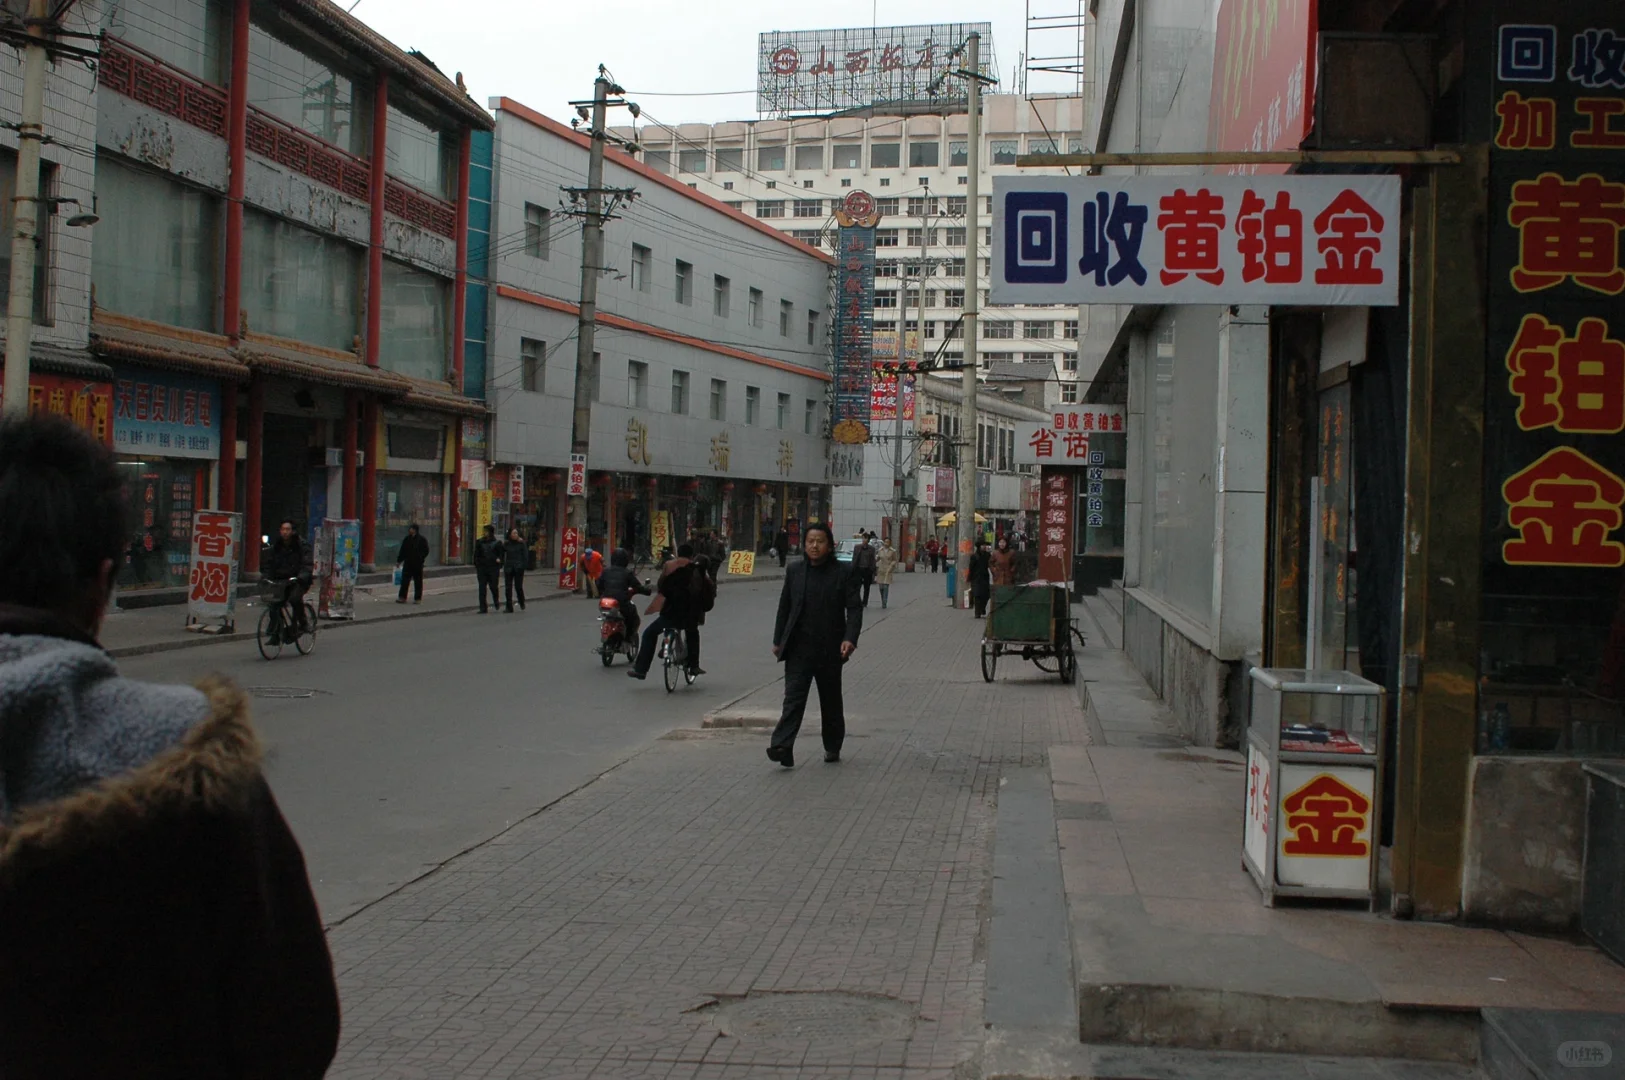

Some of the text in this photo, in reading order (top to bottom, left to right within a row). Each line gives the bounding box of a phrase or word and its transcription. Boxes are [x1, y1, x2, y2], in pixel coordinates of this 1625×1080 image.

[1498, 24, 1625, 90] 回收
[1494, 90, 1625, 151] 加工
[1004, 187, 1385, 288] 回收黄铂金
[1502, 171, 1625, 568] 黄铂金
[624, 415, 794, 477] 凯瑞祥
[1028, 427, 1089, 459] 省话
[1054, 412, 1123, 432] 回收黄铂金
[570, 463, 584, 495] 黄铂金
[1088, 450, 1105, 528] 回收黄铂金
[190, 514, 232, 604] 香烟
[562, 528, 577, 587] 全场2元
[1282, 771, 1372, 858] 金
